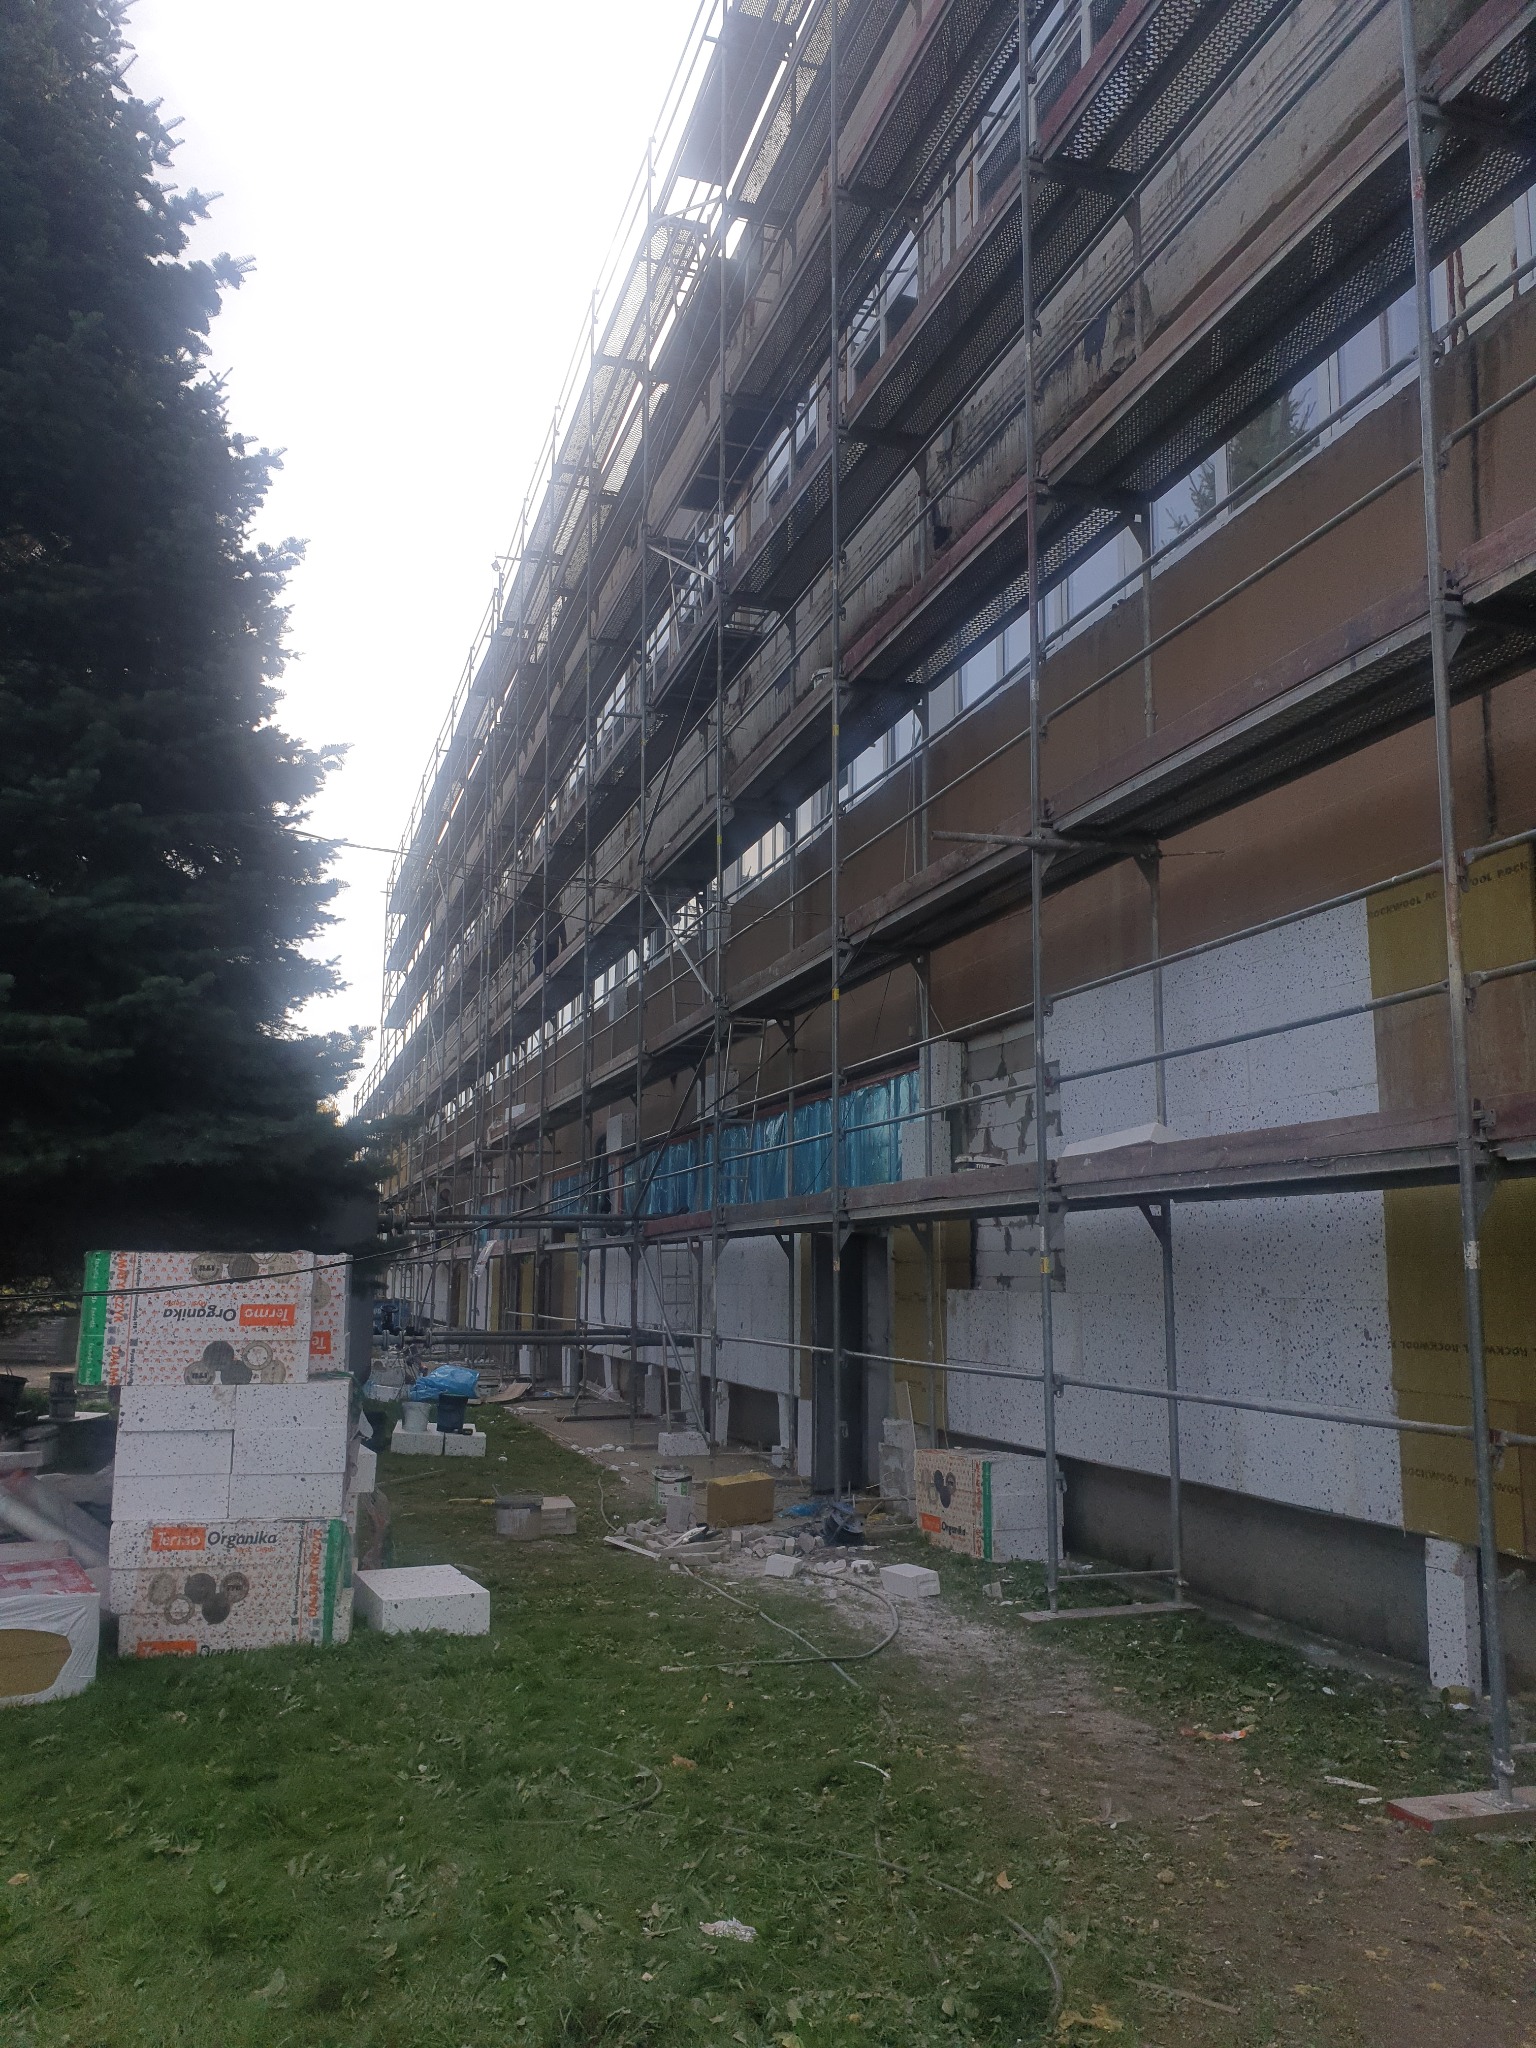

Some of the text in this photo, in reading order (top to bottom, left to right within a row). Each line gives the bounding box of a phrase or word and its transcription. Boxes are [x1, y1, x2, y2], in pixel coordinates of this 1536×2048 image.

[162, 1305, 289, 1322] Termo Organika
[158, 1531, 278, 1549] Termo Organika
